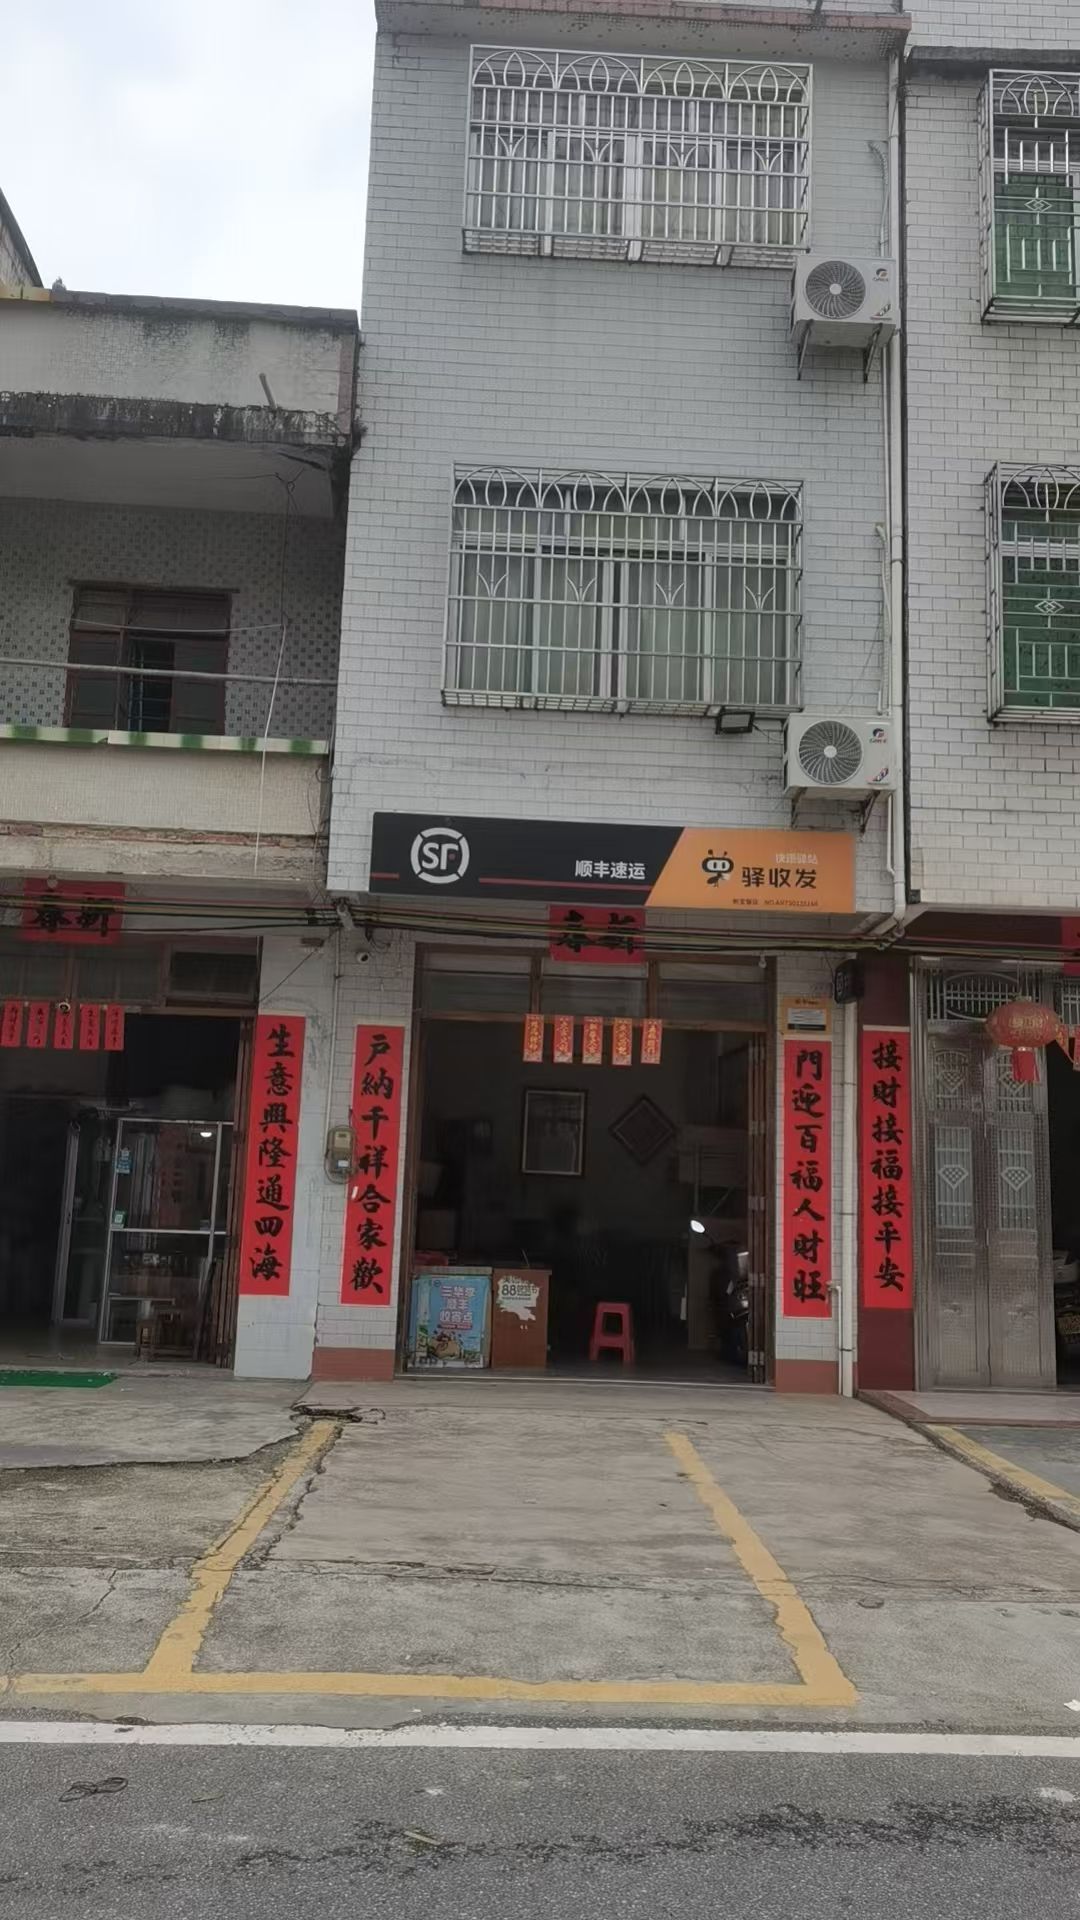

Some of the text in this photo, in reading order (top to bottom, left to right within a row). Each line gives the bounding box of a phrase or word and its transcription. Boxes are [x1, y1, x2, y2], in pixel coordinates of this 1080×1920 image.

[575, 860, 646, 880] 顺丰速运
[741, 866, 817, 889] 驿收发
[249, 1023, 295, 1280] 生意興隆通四海
